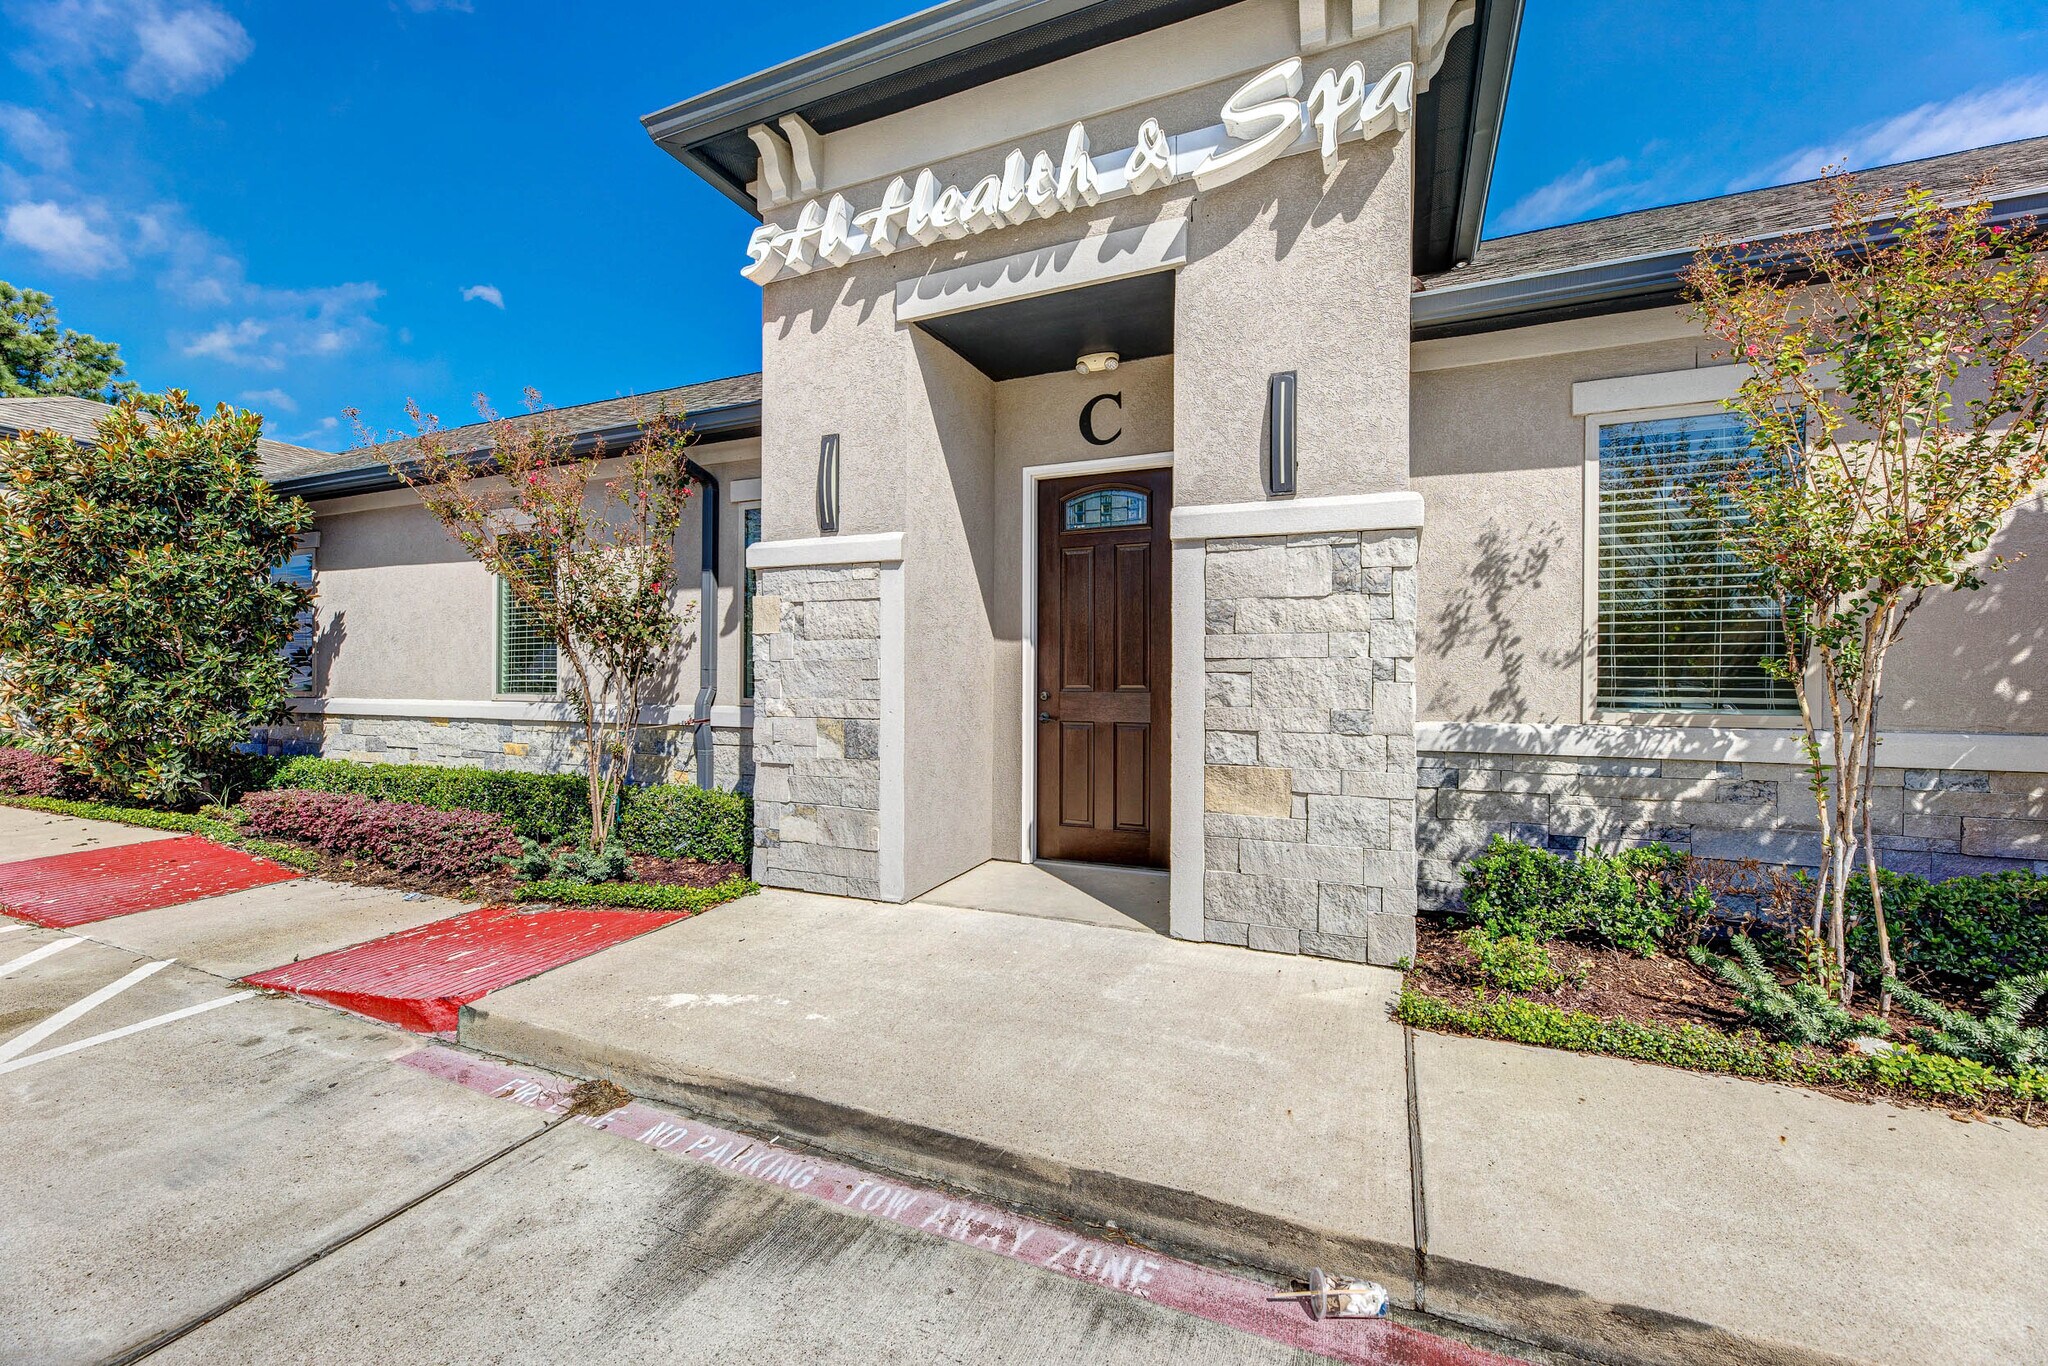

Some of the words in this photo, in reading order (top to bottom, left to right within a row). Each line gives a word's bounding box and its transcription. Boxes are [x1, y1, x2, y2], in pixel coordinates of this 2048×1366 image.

[852, 121, 1099, 254] Health
[1124, 117, 1171, 194] &
[1192, 56, 1414, 189] Spa
[1079, 391, 1122, 445] C
[636, 1121, 688, 1148] NO
[684, 1135, 819, 1189] PARKING
[844, 1181, 919, 1219] TOW
[919, 1204, 1036, 1256] AWAY
[1045, 1236, 1161, 1299] ZONE
